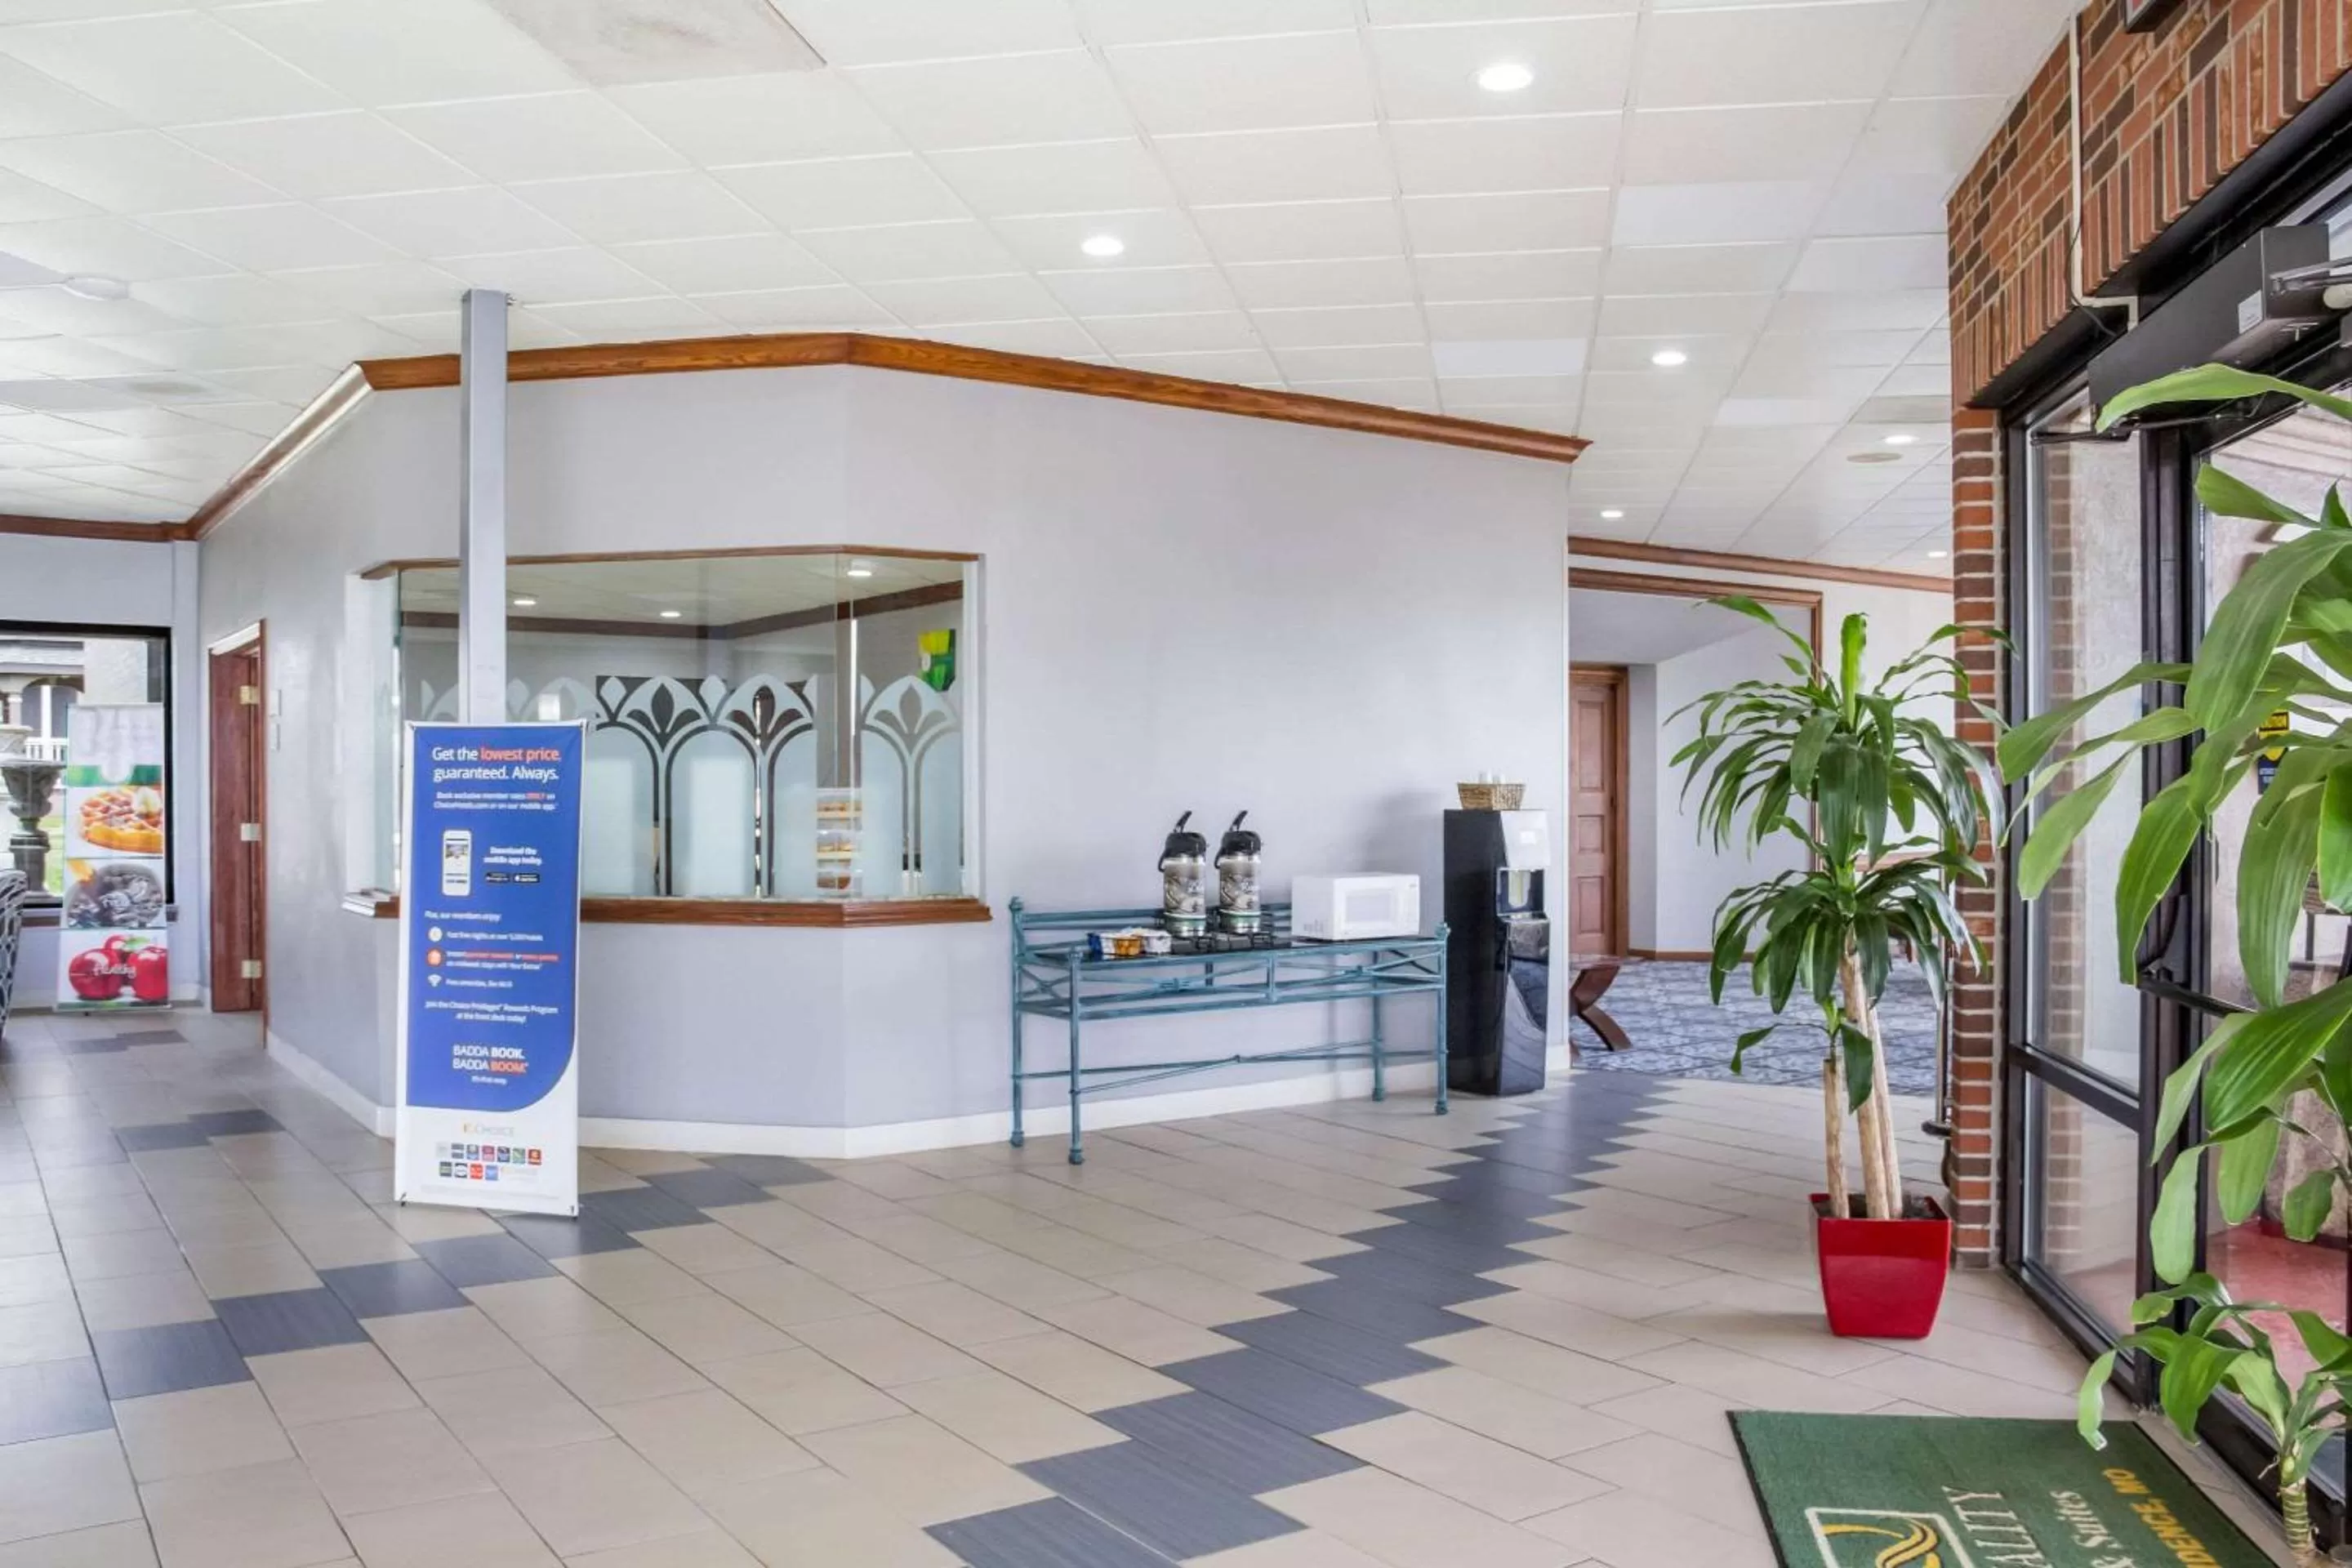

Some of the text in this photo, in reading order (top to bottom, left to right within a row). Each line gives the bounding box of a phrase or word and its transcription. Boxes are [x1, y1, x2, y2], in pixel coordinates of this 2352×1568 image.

[432, 746, 454, 761] Get
[457, 746, 478, 761] the
[481, 746, 523, 761] lowest
[433, 766, 559, 782] guaranteed. Always.
[452, 1045, 489, 1057] BADDA
[452, 1058, 490, 1070] BADDA
[2102, 1468, 2151, 1494] MO
[1941, 1486, 2054, 1568] ALITY
[2049, 1490, 2123, 1548] Suites
